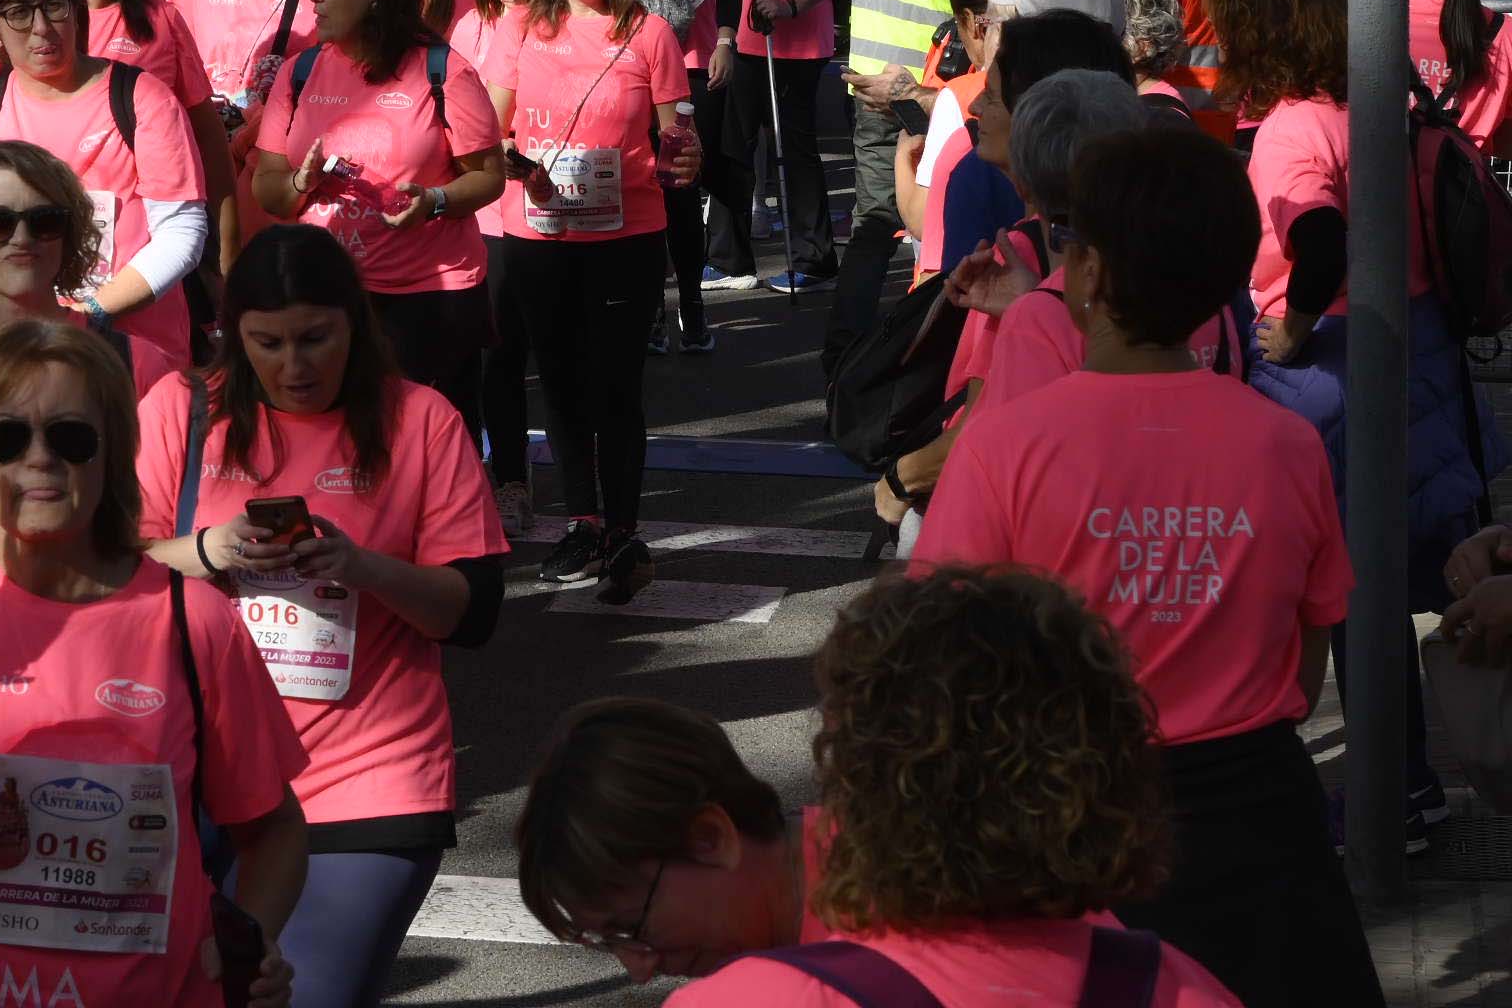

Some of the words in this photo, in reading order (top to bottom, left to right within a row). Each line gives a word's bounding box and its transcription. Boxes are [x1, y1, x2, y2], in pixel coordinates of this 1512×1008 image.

[526, 107, 550, 129] TU
[1087, 506, 1255, 539] CARRERA
[1119, 541, 1164, 572] DE
[1177, 540, 1221, 572] LA
[1107, 574, 1224, 605] MUJER
[247, 602, 299, 626] 016
[1150, 611, 1182, 623] 2023
[280, 653, 311, 664] MUJER
[315, 654, 336, 665] 2023
[288, 674, 338, 688] Santander
[101, 684, 162, 710] ASTURIANA
[38, 789, 116, 814] ASTURIANA
[35, 831, 108, 865] 016
[40, 865, 97, 887] 11988
[43, 891, 61, 903] DE
[62, 893, 78, 904] LA
[79, 895, 120, 909] MUJER
[90, 922, 153, 938] Santander
